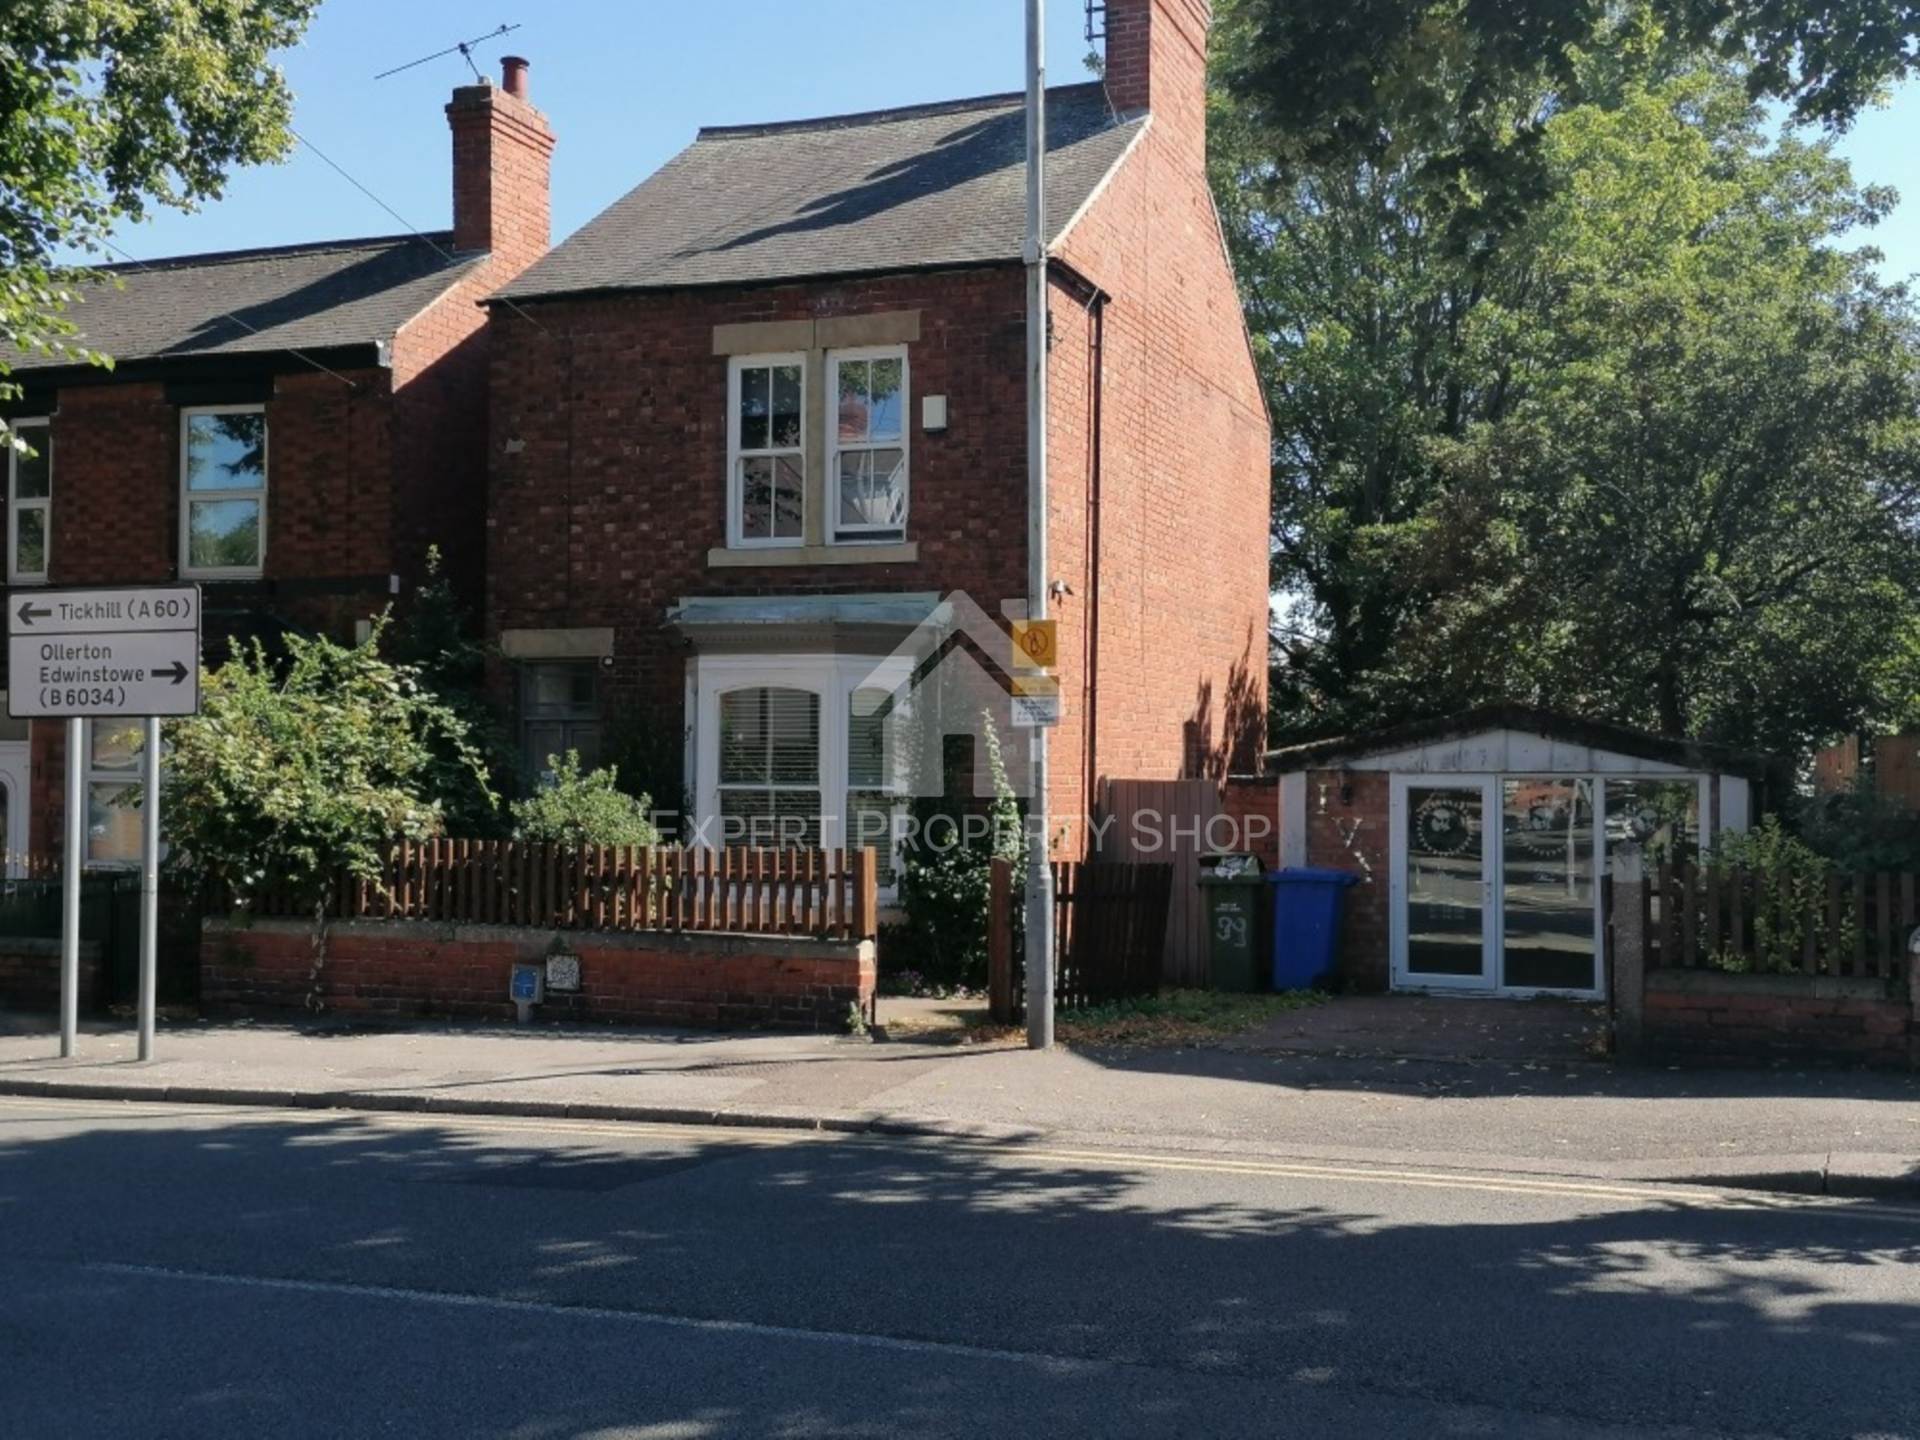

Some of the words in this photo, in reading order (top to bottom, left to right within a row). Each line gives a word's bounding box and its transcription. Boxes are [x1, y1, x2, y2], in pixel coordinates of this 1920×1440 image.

[59, 602, 122, 620] Tickhill
[40, 644, 112, 661] Ollerton
[40, 666, 144, 684] Edwinstowe
[40, 687, 126, 708] (B6034)
